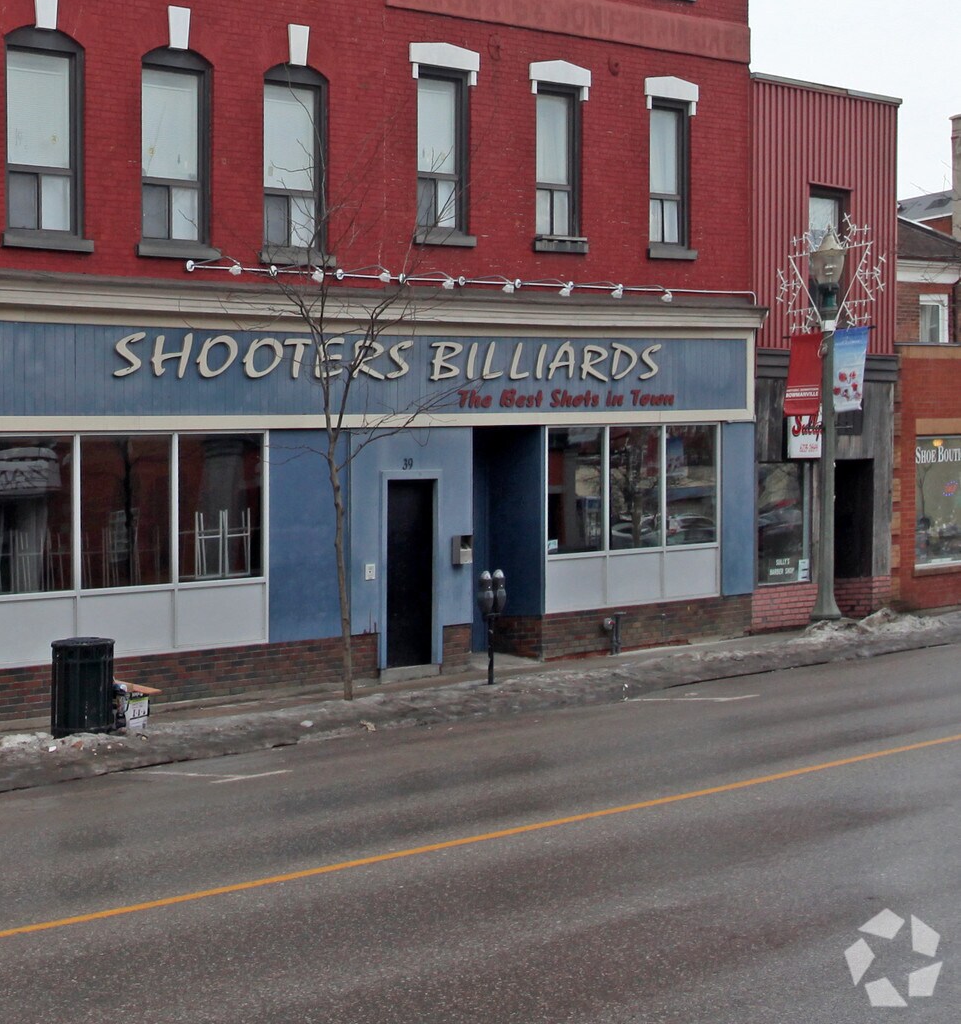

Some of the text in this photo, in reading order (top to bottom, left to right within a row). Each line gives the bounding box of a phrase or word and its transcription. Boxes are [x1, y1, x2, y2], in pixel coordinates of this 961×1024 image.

[113, 331, 662, 382] SHOOTERS BILLIARDS
[458, 388, 675, 408] The Best Shots in Town
[402, 457, 414, 470] 39
[915, 446, 937, 464] SHOE
